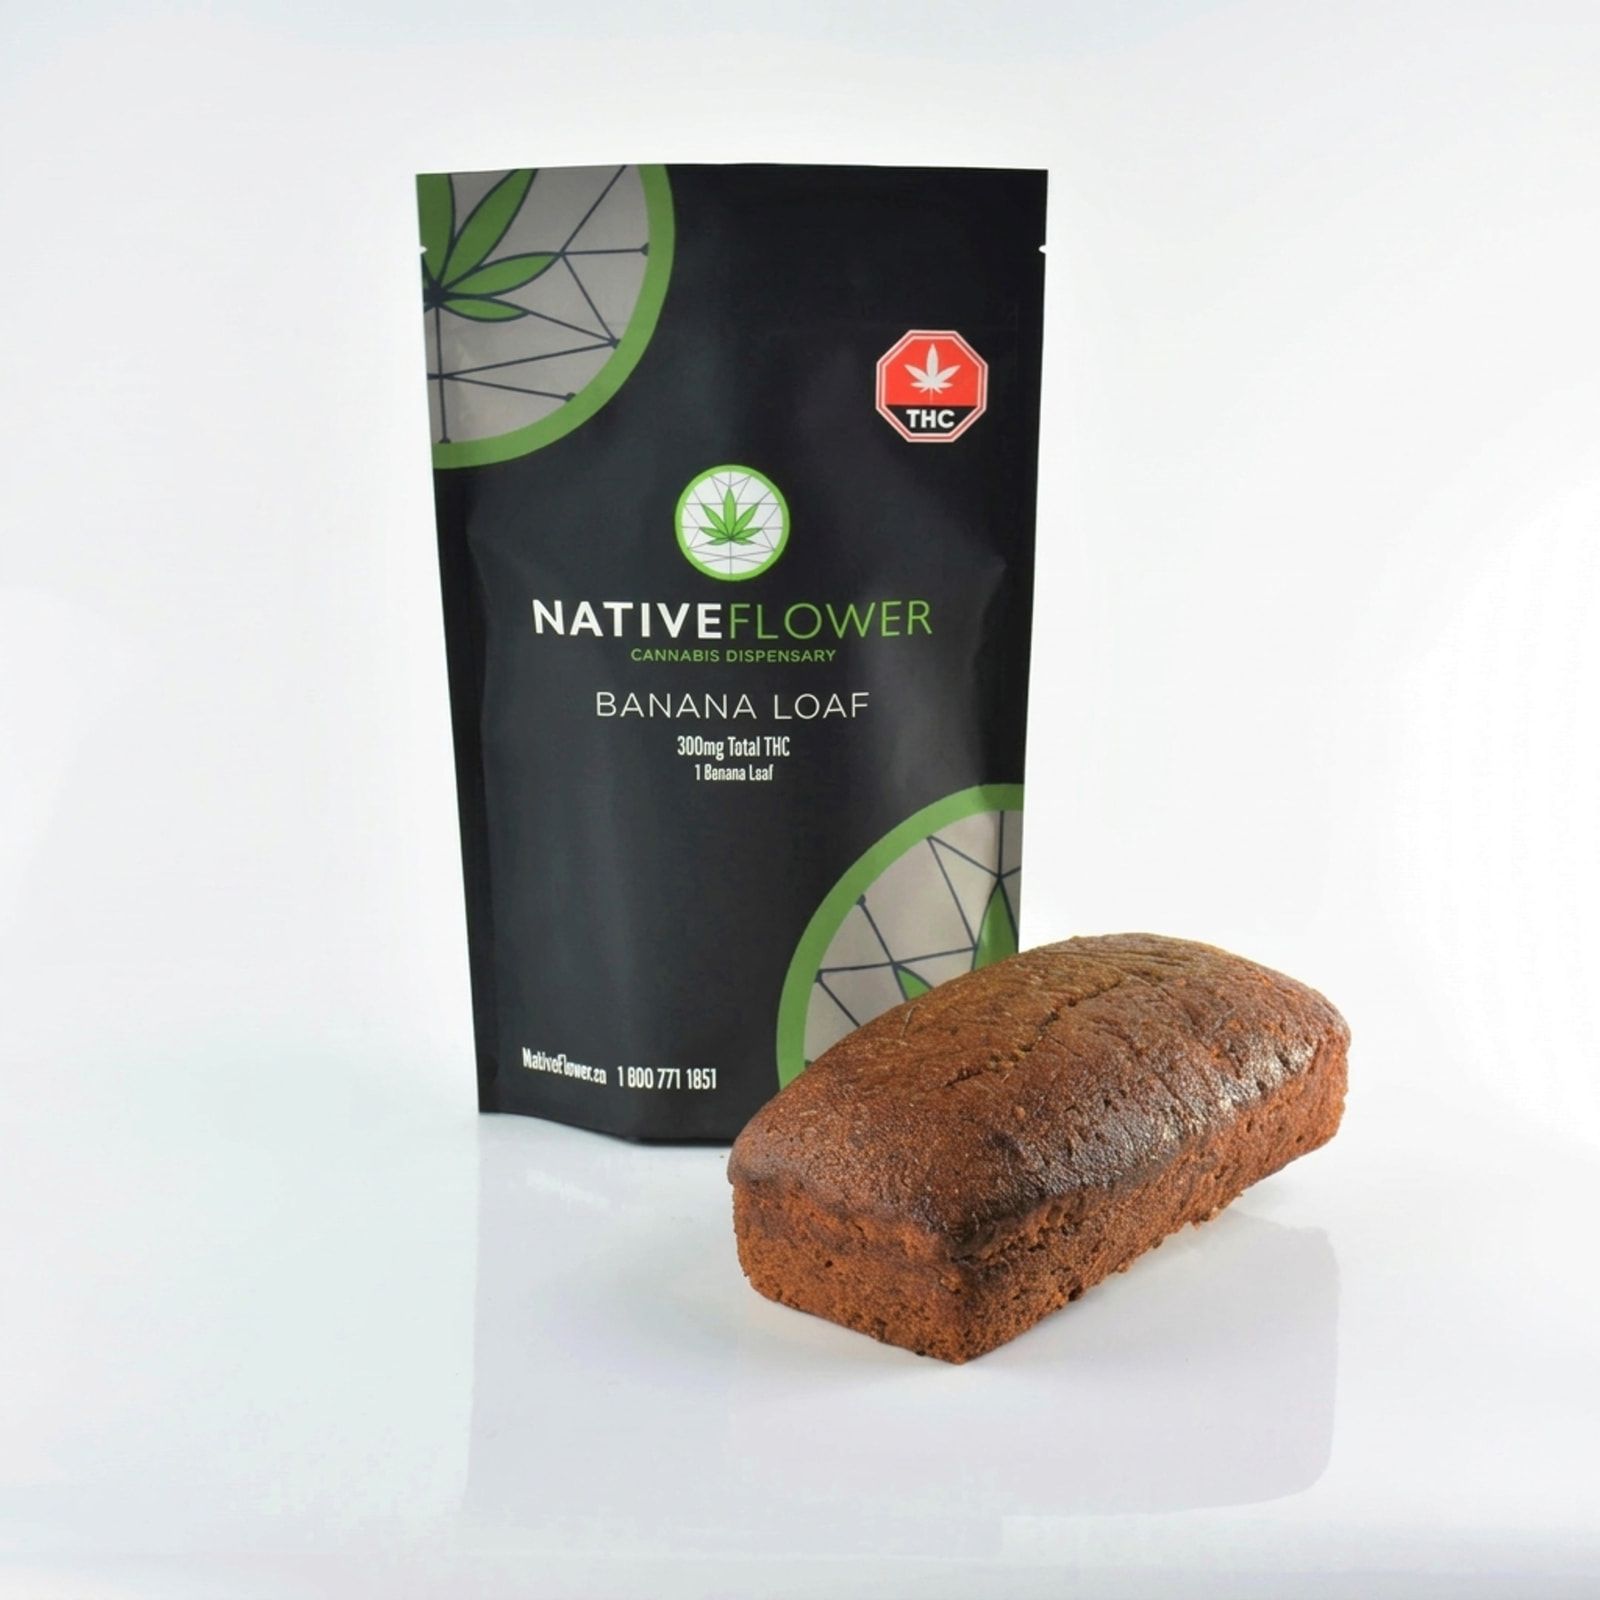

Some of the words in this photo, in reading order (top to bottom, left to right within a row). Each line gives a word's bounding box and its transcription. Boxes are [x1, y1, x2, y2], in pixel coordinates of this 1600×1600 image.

[906, 408, 955, 429] THC
[631, 648, 719, 663] CANNABIS
[725, 649, 836, 663] DISPENSARY
[596, 691, 756, 720] BANANA
[774, 691, 870, 720] LOAF
[677, 735, 724, 762] 300mg
[727, 736, 760, 757] Total
[764, 736, 791, 757] THC
[694, 763, 701, 781] 1
[617, 1066, 624, 1088] 1
[628, 1066, 654, 1089] 800
[657, 1068, 681, 1090] 771
[686, 1067, 717, 1090] 1851
